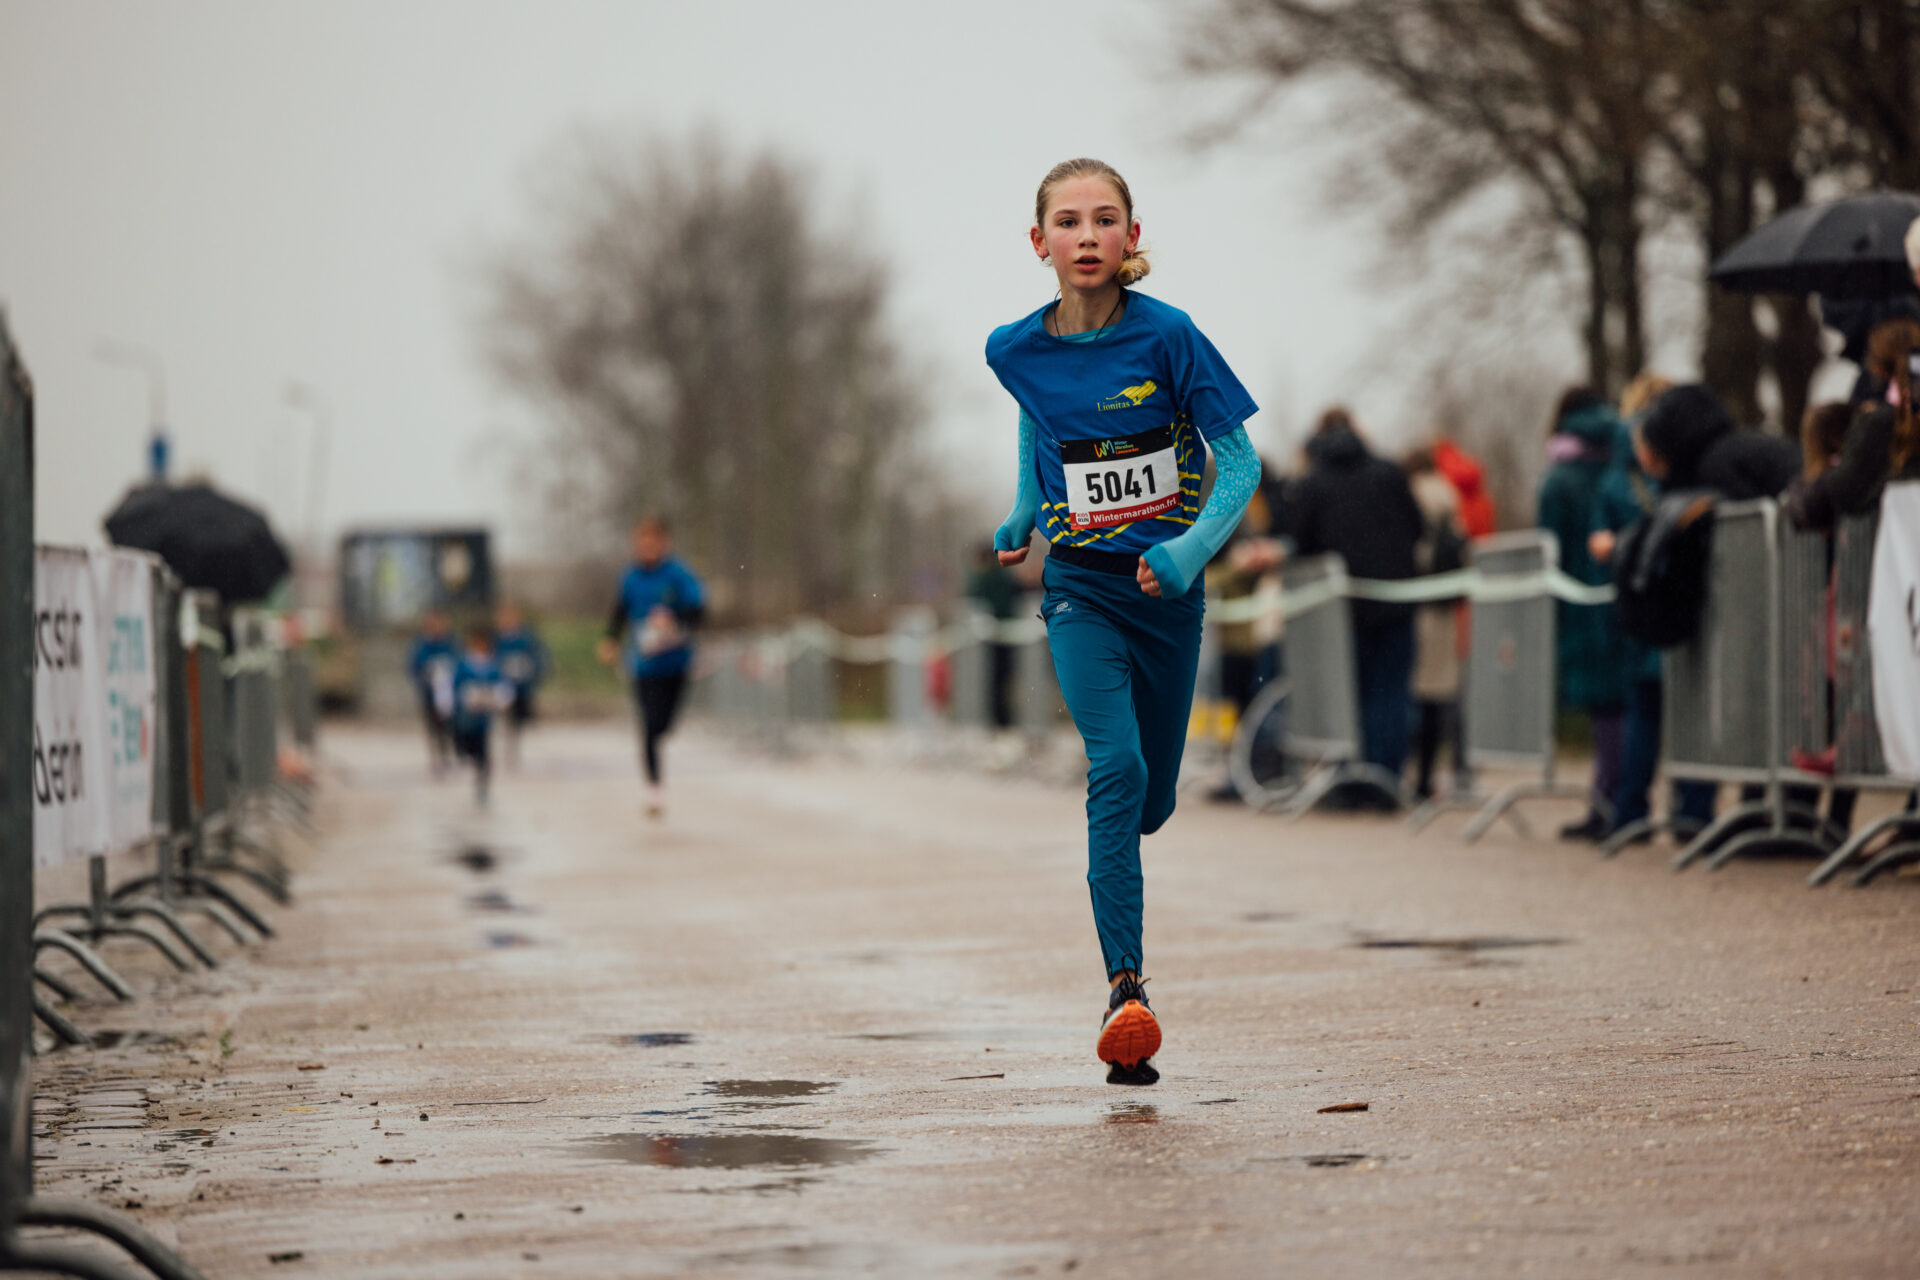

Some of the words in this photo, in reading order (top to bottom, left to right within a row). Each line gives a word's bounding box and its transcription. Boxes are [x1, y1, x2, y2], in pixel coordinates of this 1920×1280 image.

[1097, 401, 1130, 412] Lionitas
[1085, 464, 1156, 504] 5041
[1093, 497, 1177, 523] Wintermarathon.frl
